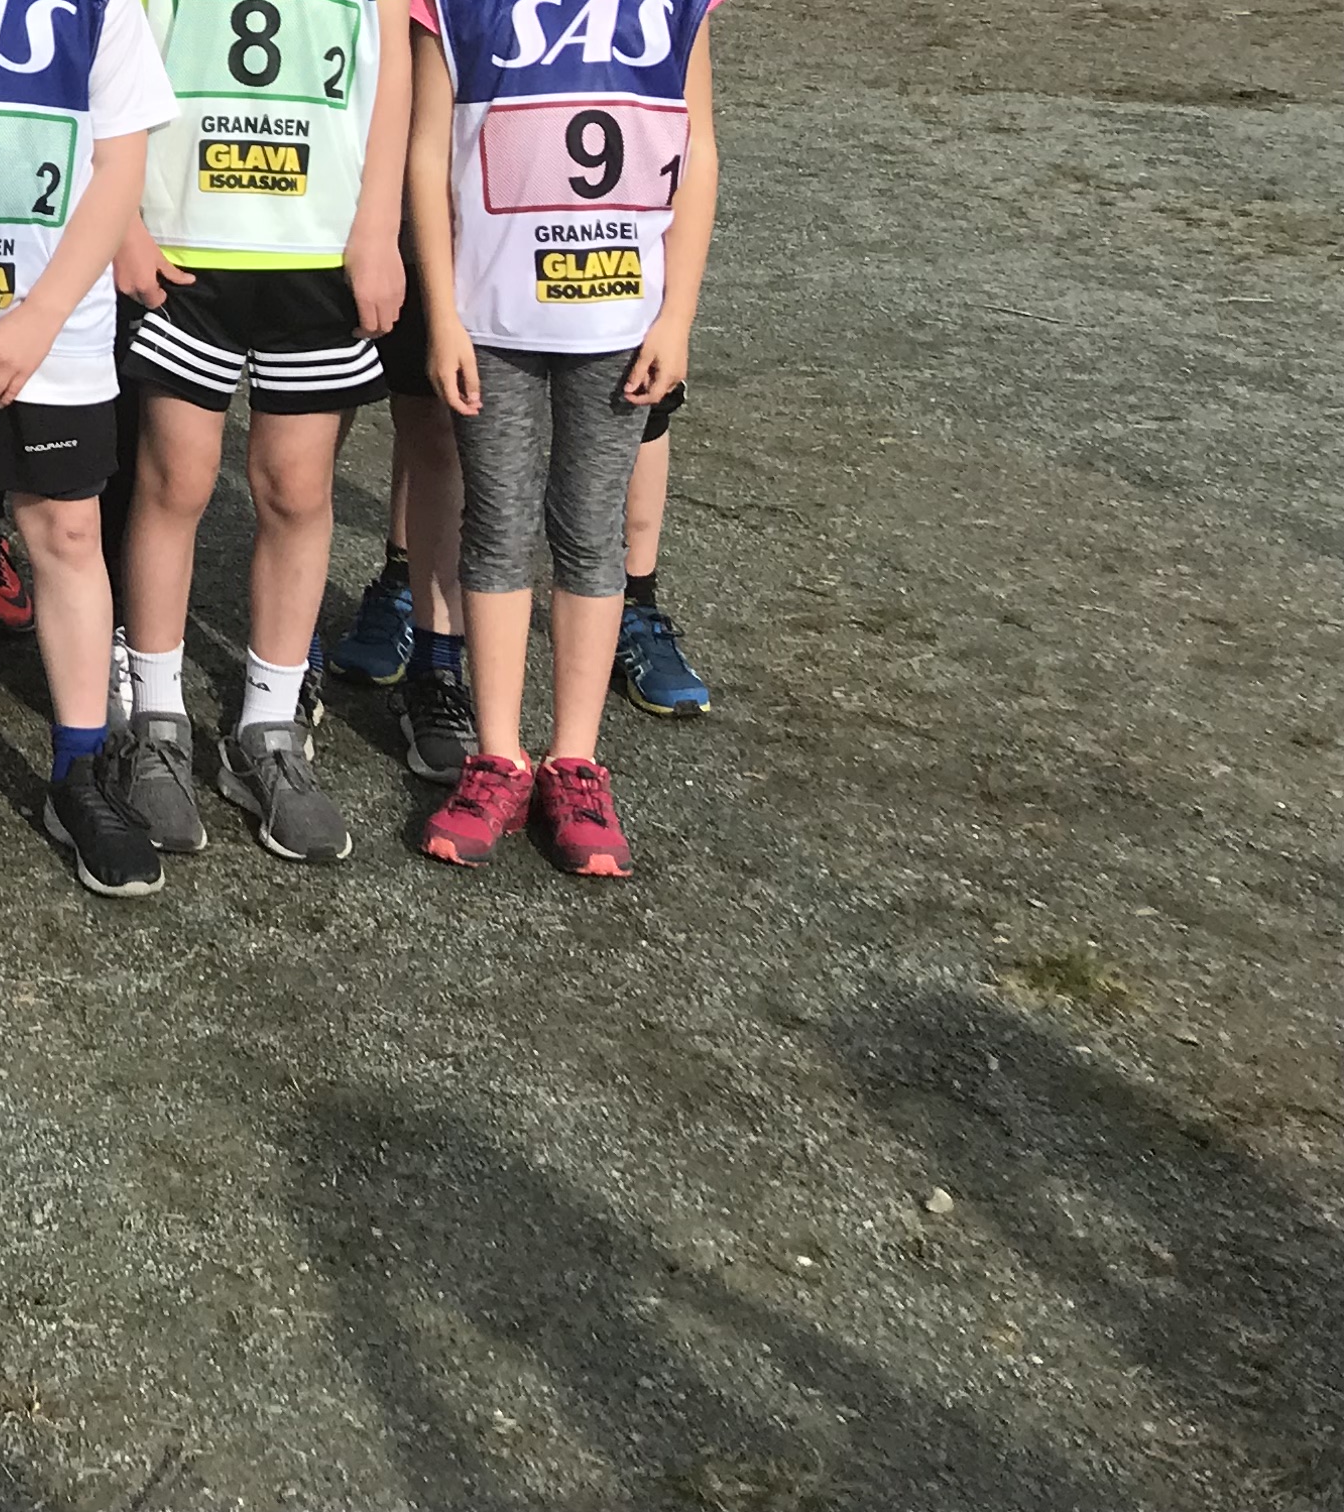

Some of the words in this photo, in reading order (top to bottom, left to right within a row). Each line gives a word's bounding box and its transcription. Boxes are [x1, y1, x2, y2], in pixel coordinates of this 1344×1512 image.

[323, 45, 346, 100] 2
[201, 112, 310, 138] GRANÅSEN
[205, 143, 300, 172] GLAVA
[565, 109, 624, 200] 9
[659, 154, 681, 206] 1
[33, 161, 61, 216] 2
[208, 173, 300, 194] ISOLASJON
[542, 250, 642, 280] GLAVA
[546, 281, 640, 299] ISOLASJON
